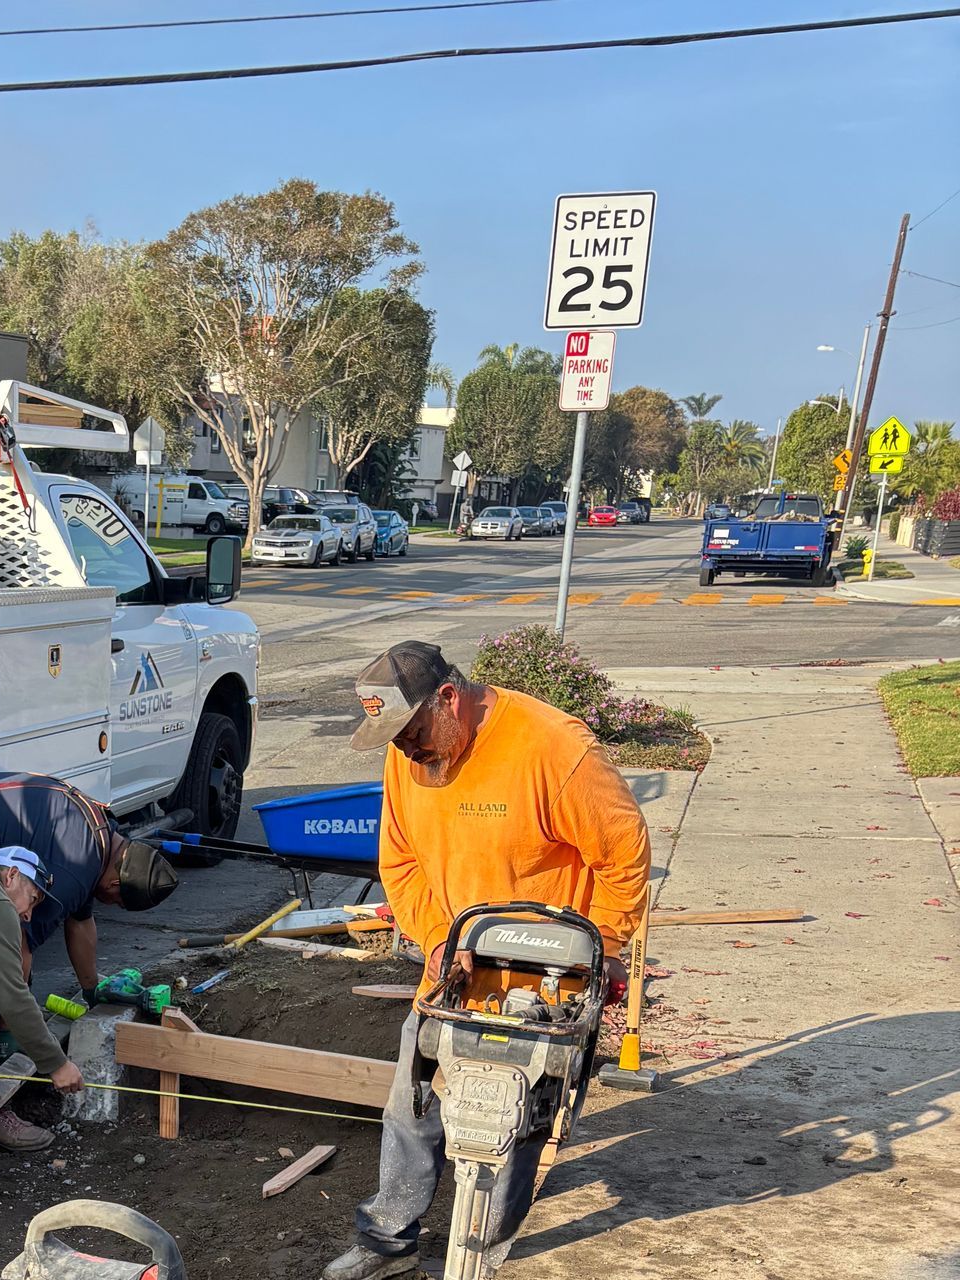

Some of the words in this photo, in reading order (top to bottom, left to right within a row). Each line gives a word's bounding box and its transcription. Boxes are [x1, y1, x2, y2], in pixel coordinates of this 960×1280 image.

[563, 208, 645, 231] SPEED
[569, 237, 633, 258] LIMIT
[558, 264, 633, 312] 25
[569, 335, 586, 354] NO
[567, 358, 608, 375] PARKING
[578, 377, 595, 388] ANY
[576, 390, 594, 401] TIME
[119, 691, 173, 721] SUNSTONE
[458, 803, 476, 812] ALL
[478, 803, 507, 812] LAND
[304, 819, 378, 835] KOBALT
[494, 928, 565, 950] Mikasa
